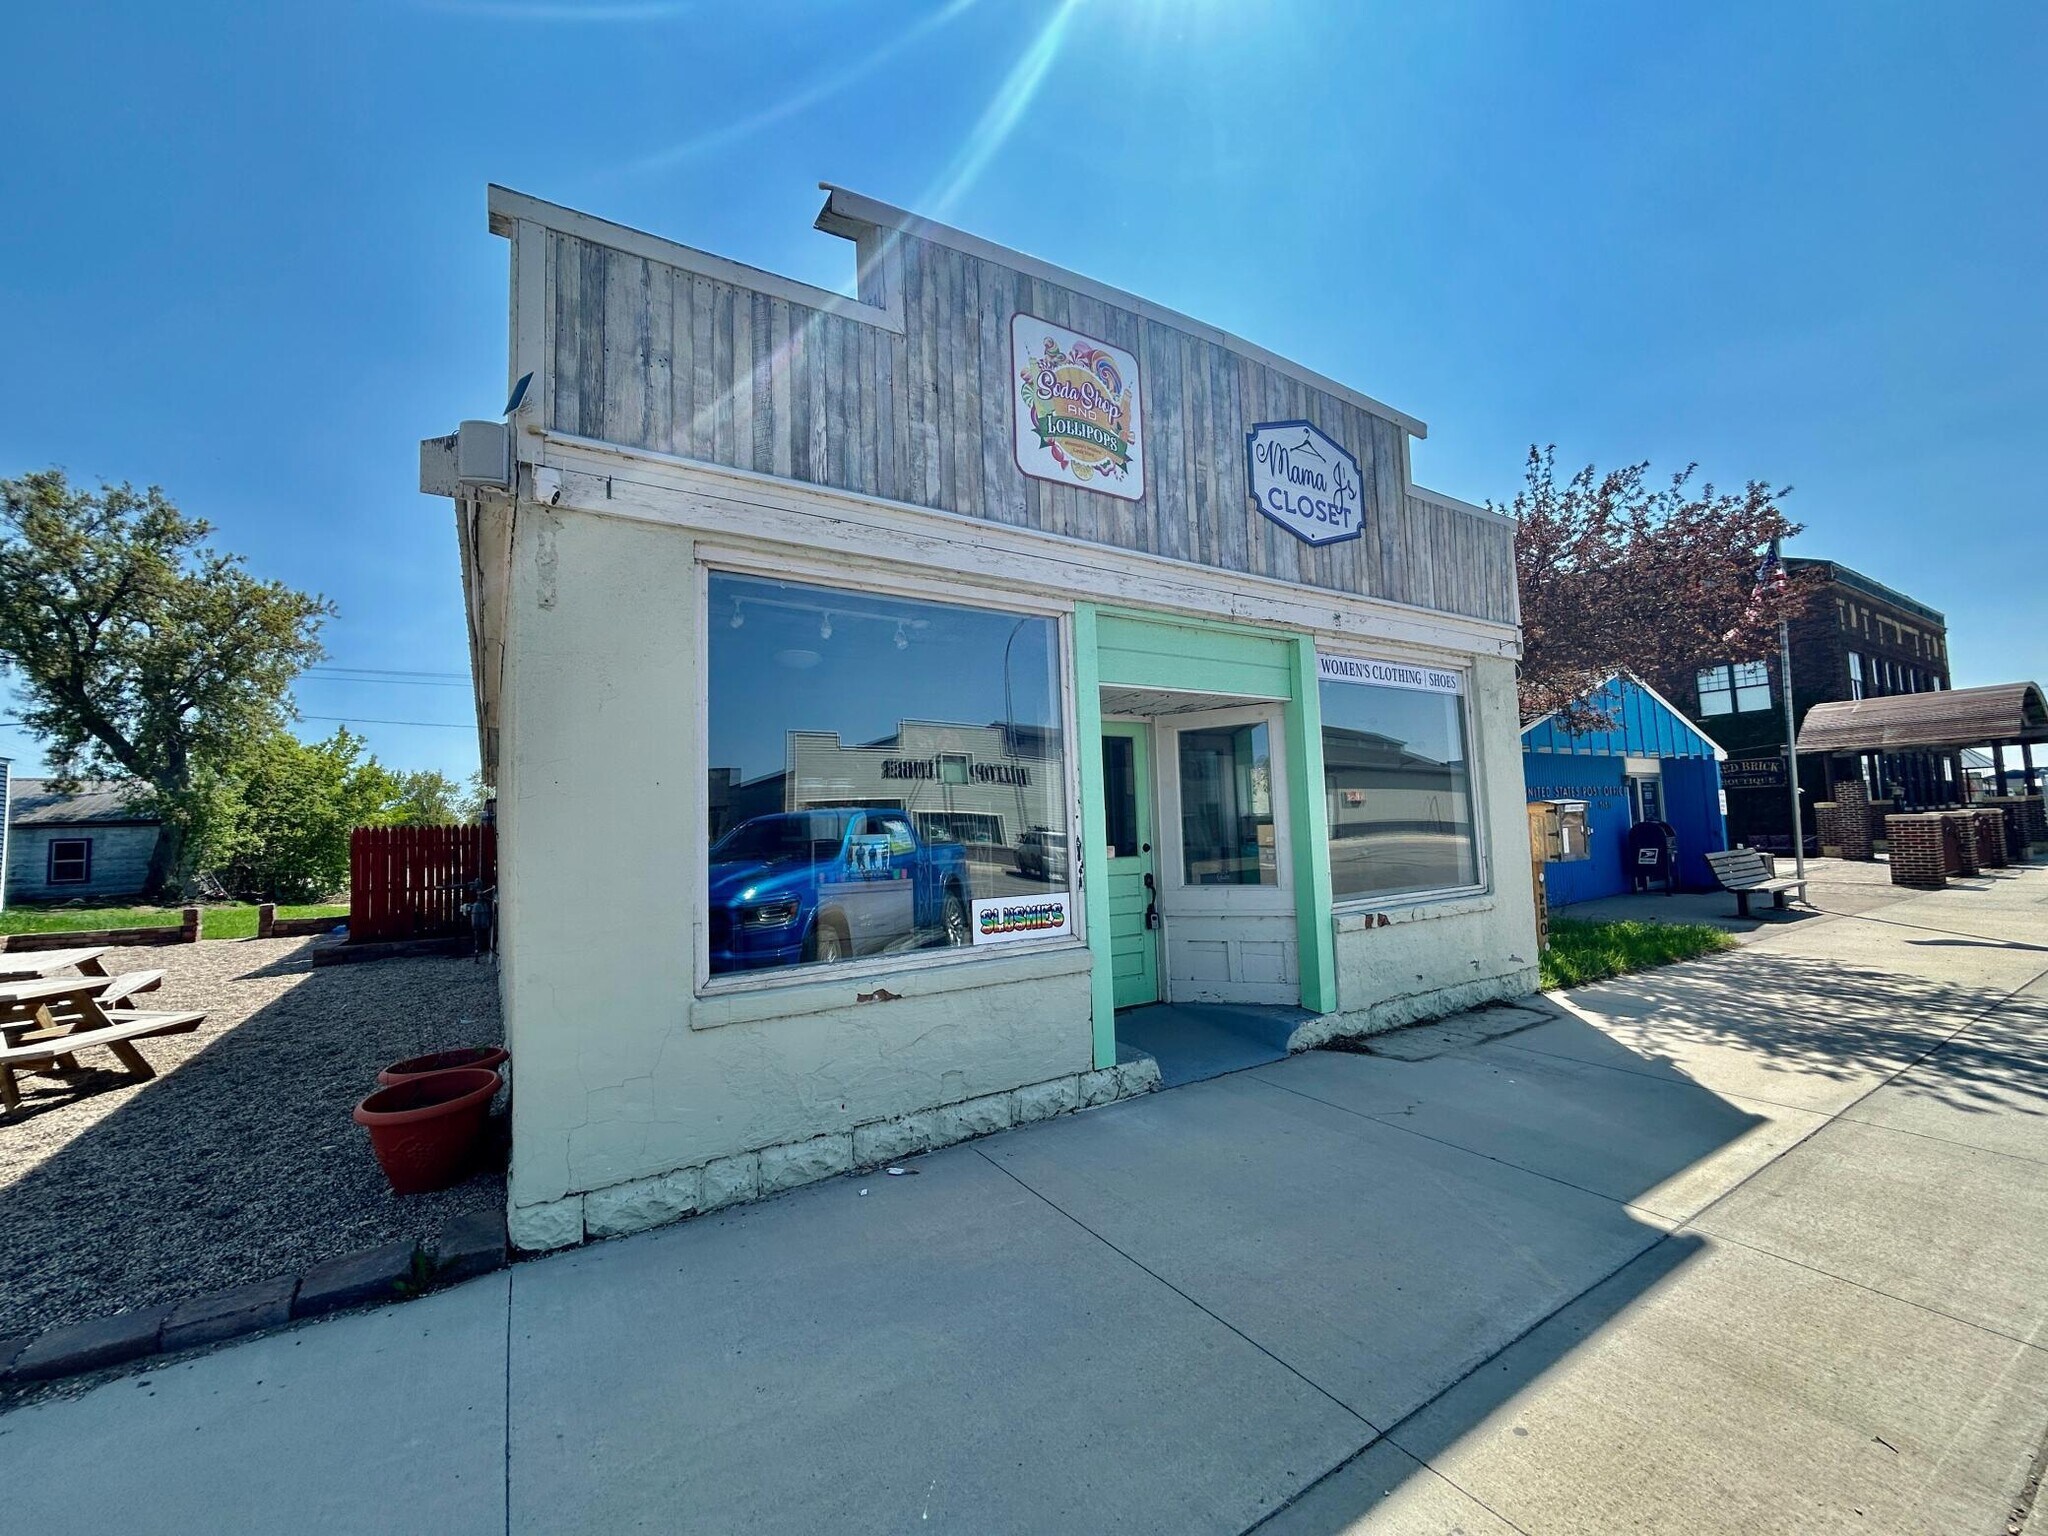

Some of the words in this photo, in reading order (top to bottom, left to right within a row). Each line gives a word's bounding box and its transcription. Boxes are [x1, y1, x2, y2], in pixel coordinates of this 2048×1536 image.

[1036, 370, 1079, 401] Soda
[1080, 381, 1122, 425] Shop
[1067, 404, 1097, 421] AND
[1047, 414, 1118, 452] LOLLIPOPS
[1256, 440, 1327, 492] Mama
[1333, 461, 1357, 515] J's
[1268, 487, 1352, 528] CLOSET
[1321, 658, 1370, 679] WOMEN'S
[1372, 665, 1422, 685] CLOTHING
[1429, 672, 1457, 689] SHOES
[1720, 763, 1739, 774] ED
[1741, 761, 1780, 773] BRICK
[1527, 786, 1553, 799] NITED
[1555, 786, 1580, 798] STATES
[1582, 786, 1601, 797] POST
[980, 902, 1065, 935] SLUSHIES
